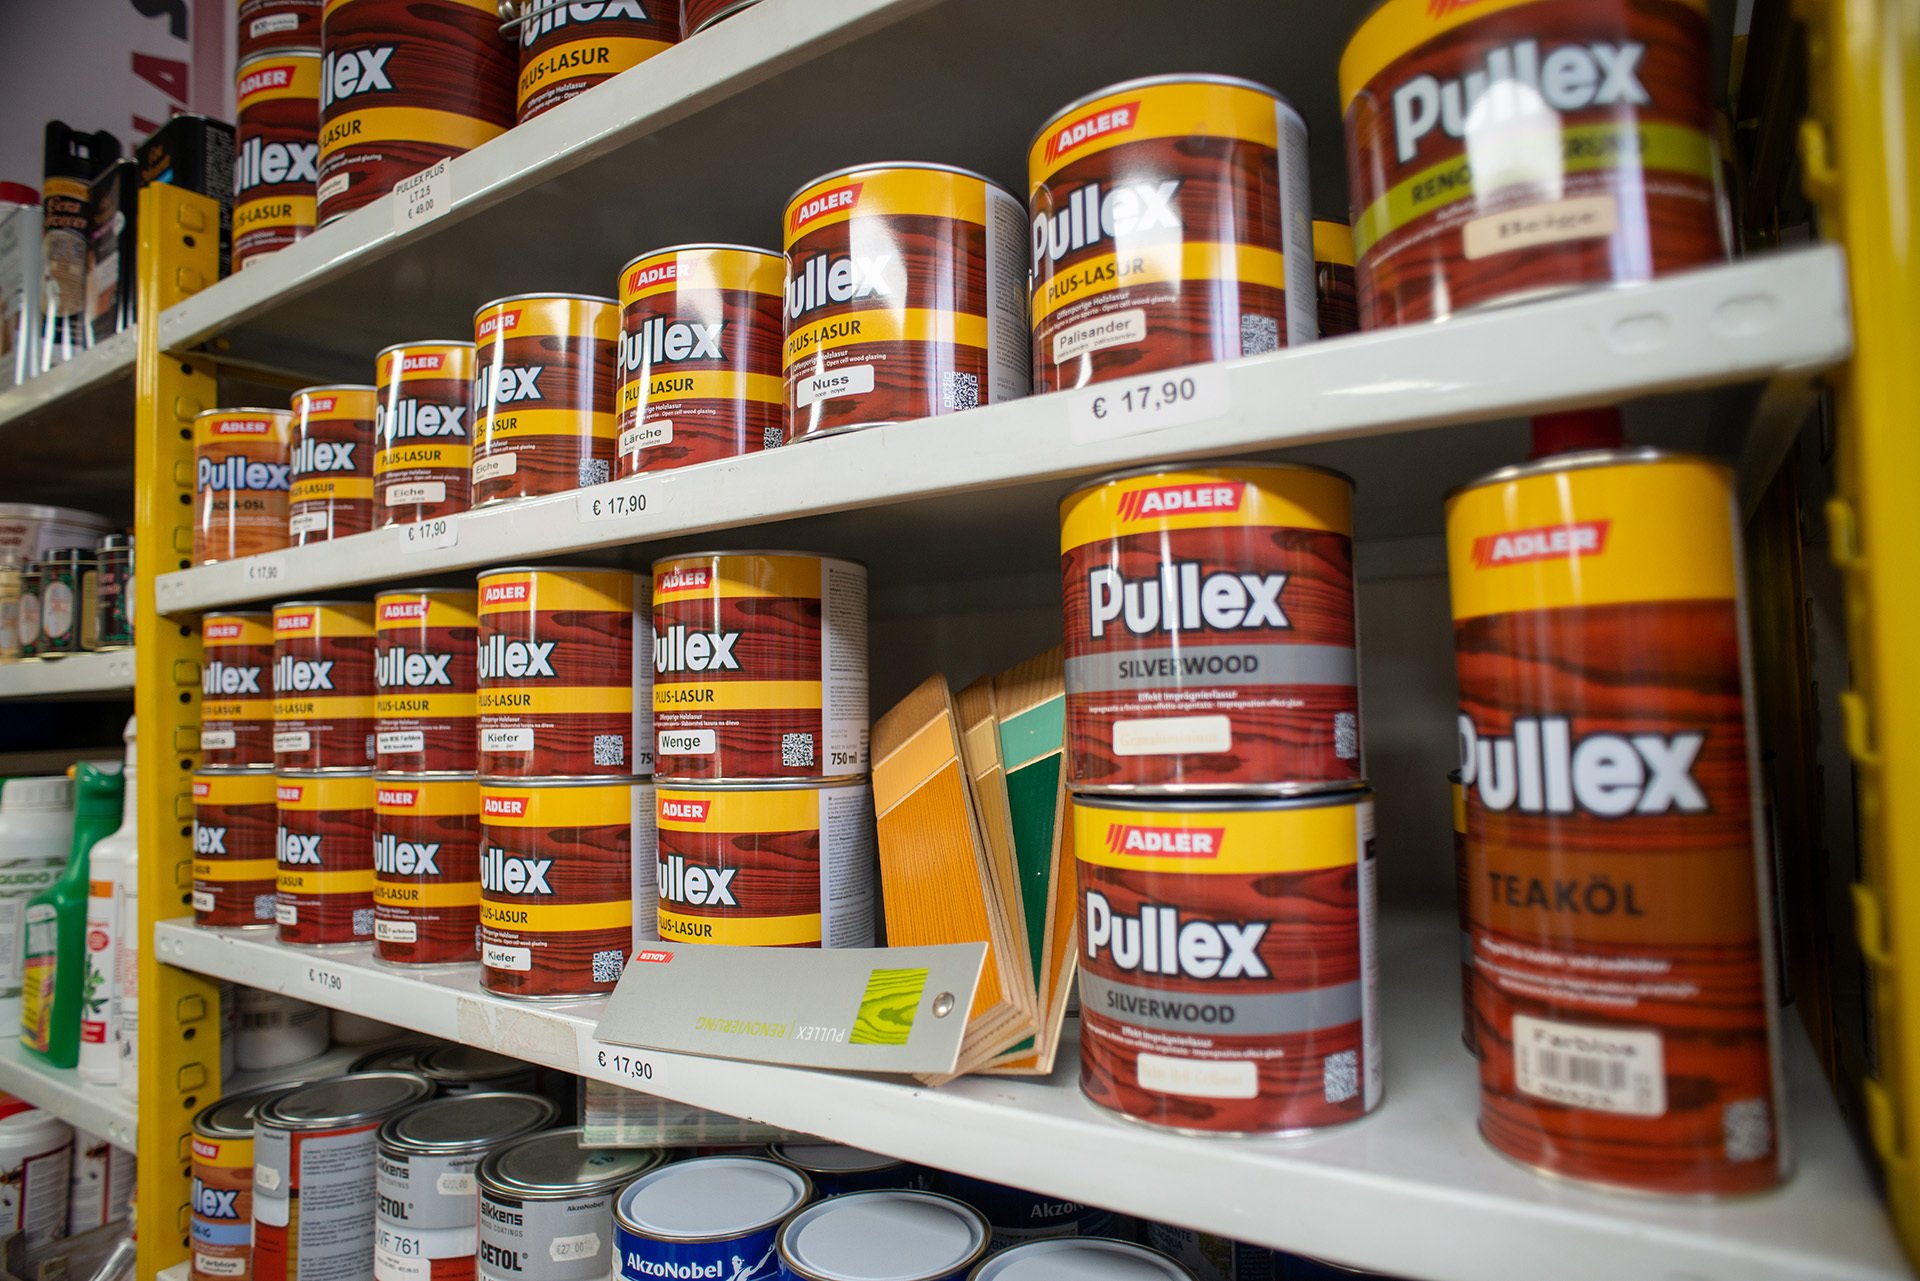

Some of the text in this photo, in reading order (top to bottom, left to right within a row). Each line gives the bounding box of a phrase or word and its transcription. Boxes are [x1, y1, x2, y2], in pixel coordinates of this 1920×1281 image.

[520, 47, 610, 92] PLUS-LASUR
[238, 69, 287, 96] ADLER
[1393, 39, 1651, 164] Pullex
[1058, 108, 1130, 153] ADLER
[396, 163, 445, 196] PULLEX PLUS
[408, 207, 414, 219] €
[799, 189, 853, 223] ADLER
[1033, 180, 1182, 279] Pullex
[637, 263, 690, 287] ADLER
[1048, 258, 1145, 303] PLUS-LASUR
[1093, 292, 1130, 308] Holzlasur
[1102, 304, 1118, 313] Open
[1132, 298, 1150, 306] wood
[479, 315, 515, 337] ADLER
[789, 319, 861, 354] PLUS-LASUR
[1060, 319, 1131, 349] Palisander
[618, 318, 723, 380] Pullex
[826, 359, 839, 367] Open
[865, 353, 887, 361] glazing
[812, 375, 850, 392] Nuss
[1092, 377, 1196, 419] € 17,90
[220, 421, 267, 434] ADLER
[375, 398, 467, 445] Pullex
[624, 428, 663, 447] Lärche
[381, 450, 442, 466] PLUS-LASUR
[476, 461, 499, 475] Eiche
[197, 455, 291, 494] Pullex
[393, 487, 425, 498] Eiche
[1140, 486, 1236, 514] ADLER
[592, 494, 647, 516] € 17,90
[408, 521, 447, 541] € 17,90
[1491, 526, 1600, 562] ADLER
[249, 566, 278, 579] € 17,90
[662, 571, 706, 590] ADLER
[485, 586, 525, 602] ADLER
[1089, 561, 1291, 638] Pullex
[384, 604, 426, 619] ADLER
[206, 625, 239, 638] ADLER
[277, 616, 309, 630] ADLER
[1118, 655, 1259, 679] SILVERWOOD
[655, 689, 715, 703] PLUS-LASUR
[1137, 692, 1163, 702] Effekt
[487, 733, 520, 743] Kiefer
[661, 734, 702, 751] Wenge
[640, 753, 653, 765] 75
[831, 751, 858, 766] 750 ml
[378, 790, 413, 805] ADLER
[485, 798, 522, 814] ADLER
[662, 801, 704, 819] ADLER
[1125, 829, 1213, 854] ADLER
[1488, 871, 1647, 918] TEAKÖL
[1086, 890, 1271, 980] Pullex
[487, 949, 517, 963] Kiefer
[640, 952, 667, 962] ADLER
[309, 969, 342, 991] € 17,90
[1106, 990, 1236, 1025] SILVERWOOD
[695, 1015, 845, 1043] PULLEX RENOVIERUNG
[597, 1051, 653, 1081] € 17,90
[480, 1202, 524, 1227] sikkens
[566, 1200, 605, 1212] AkzoNobel
[494, 1222, 524, 1239] COATINGS
[394, 1234, 421, 1256] 761
[480, 1239, 523, 1272] CETOL
[627, 1252, 724, 1280] AkzoNobel
